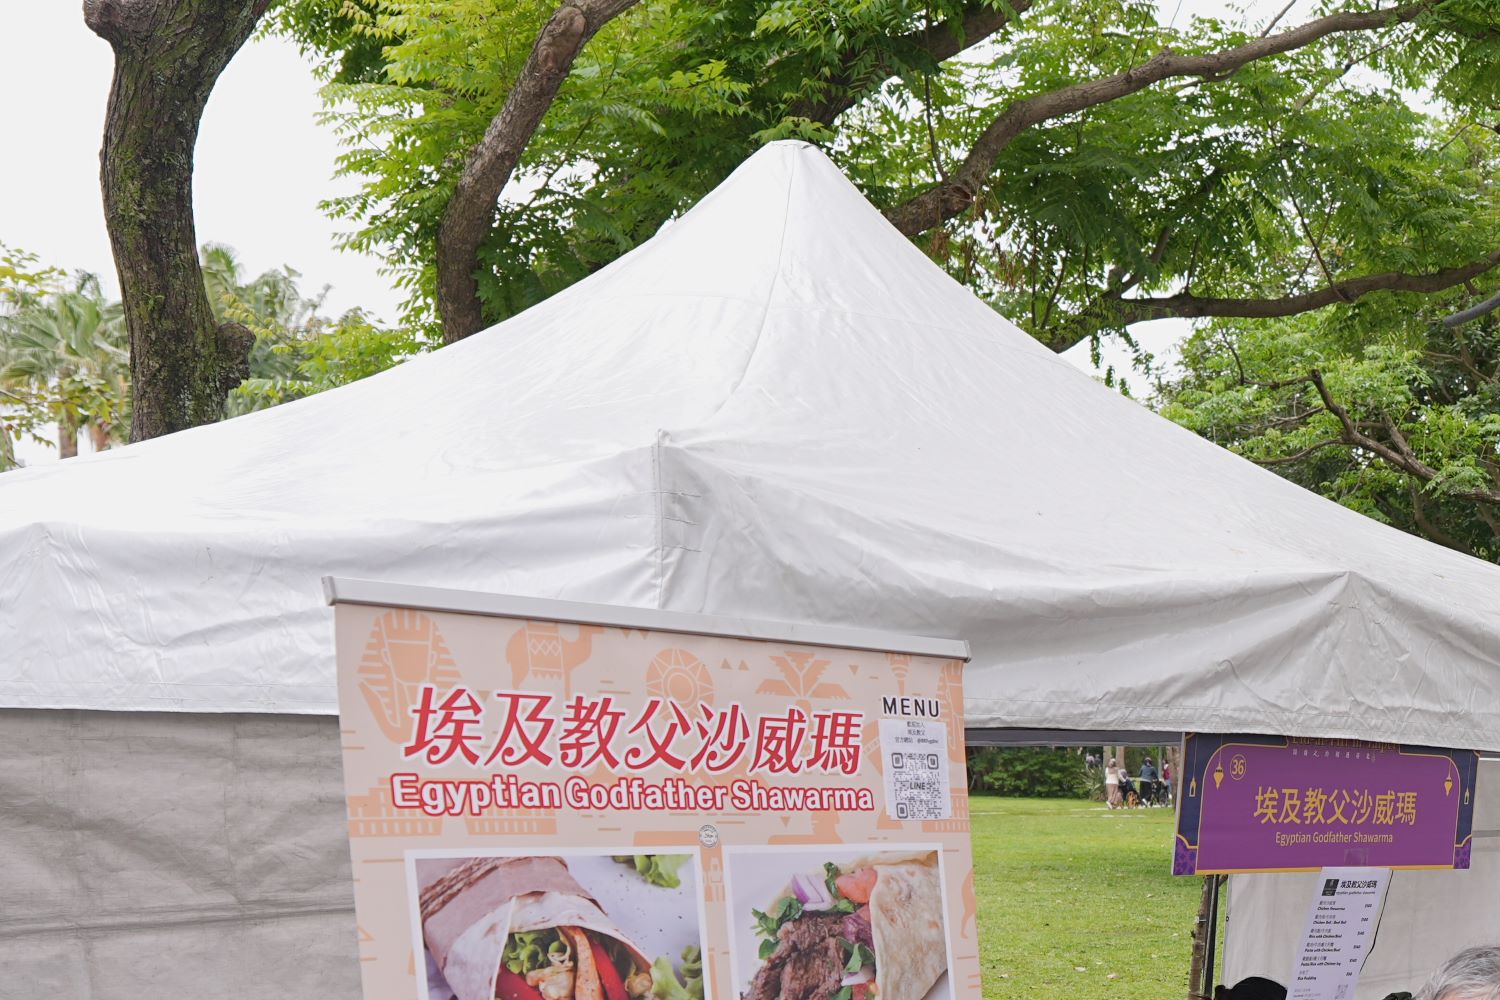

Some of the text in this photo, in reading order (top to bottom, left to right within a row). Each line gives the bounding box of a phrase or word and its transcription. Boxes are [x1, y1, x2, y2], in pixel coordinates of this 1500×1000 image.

[883, 697, 939, 717] MENU
[402, 686, 864, 776] 埃及教父沙威瑪
[1231, 759, 1245, 775] 36
[392, 772, 874, 817] Egyptian Godfather Shawarma
[910, 782, 925, 790] LINE
[1253, 785, 1418, 826] 埃及教父沙威瑪
[1275, 831, 1393, 847] Egyptian Godfather Shawarma
